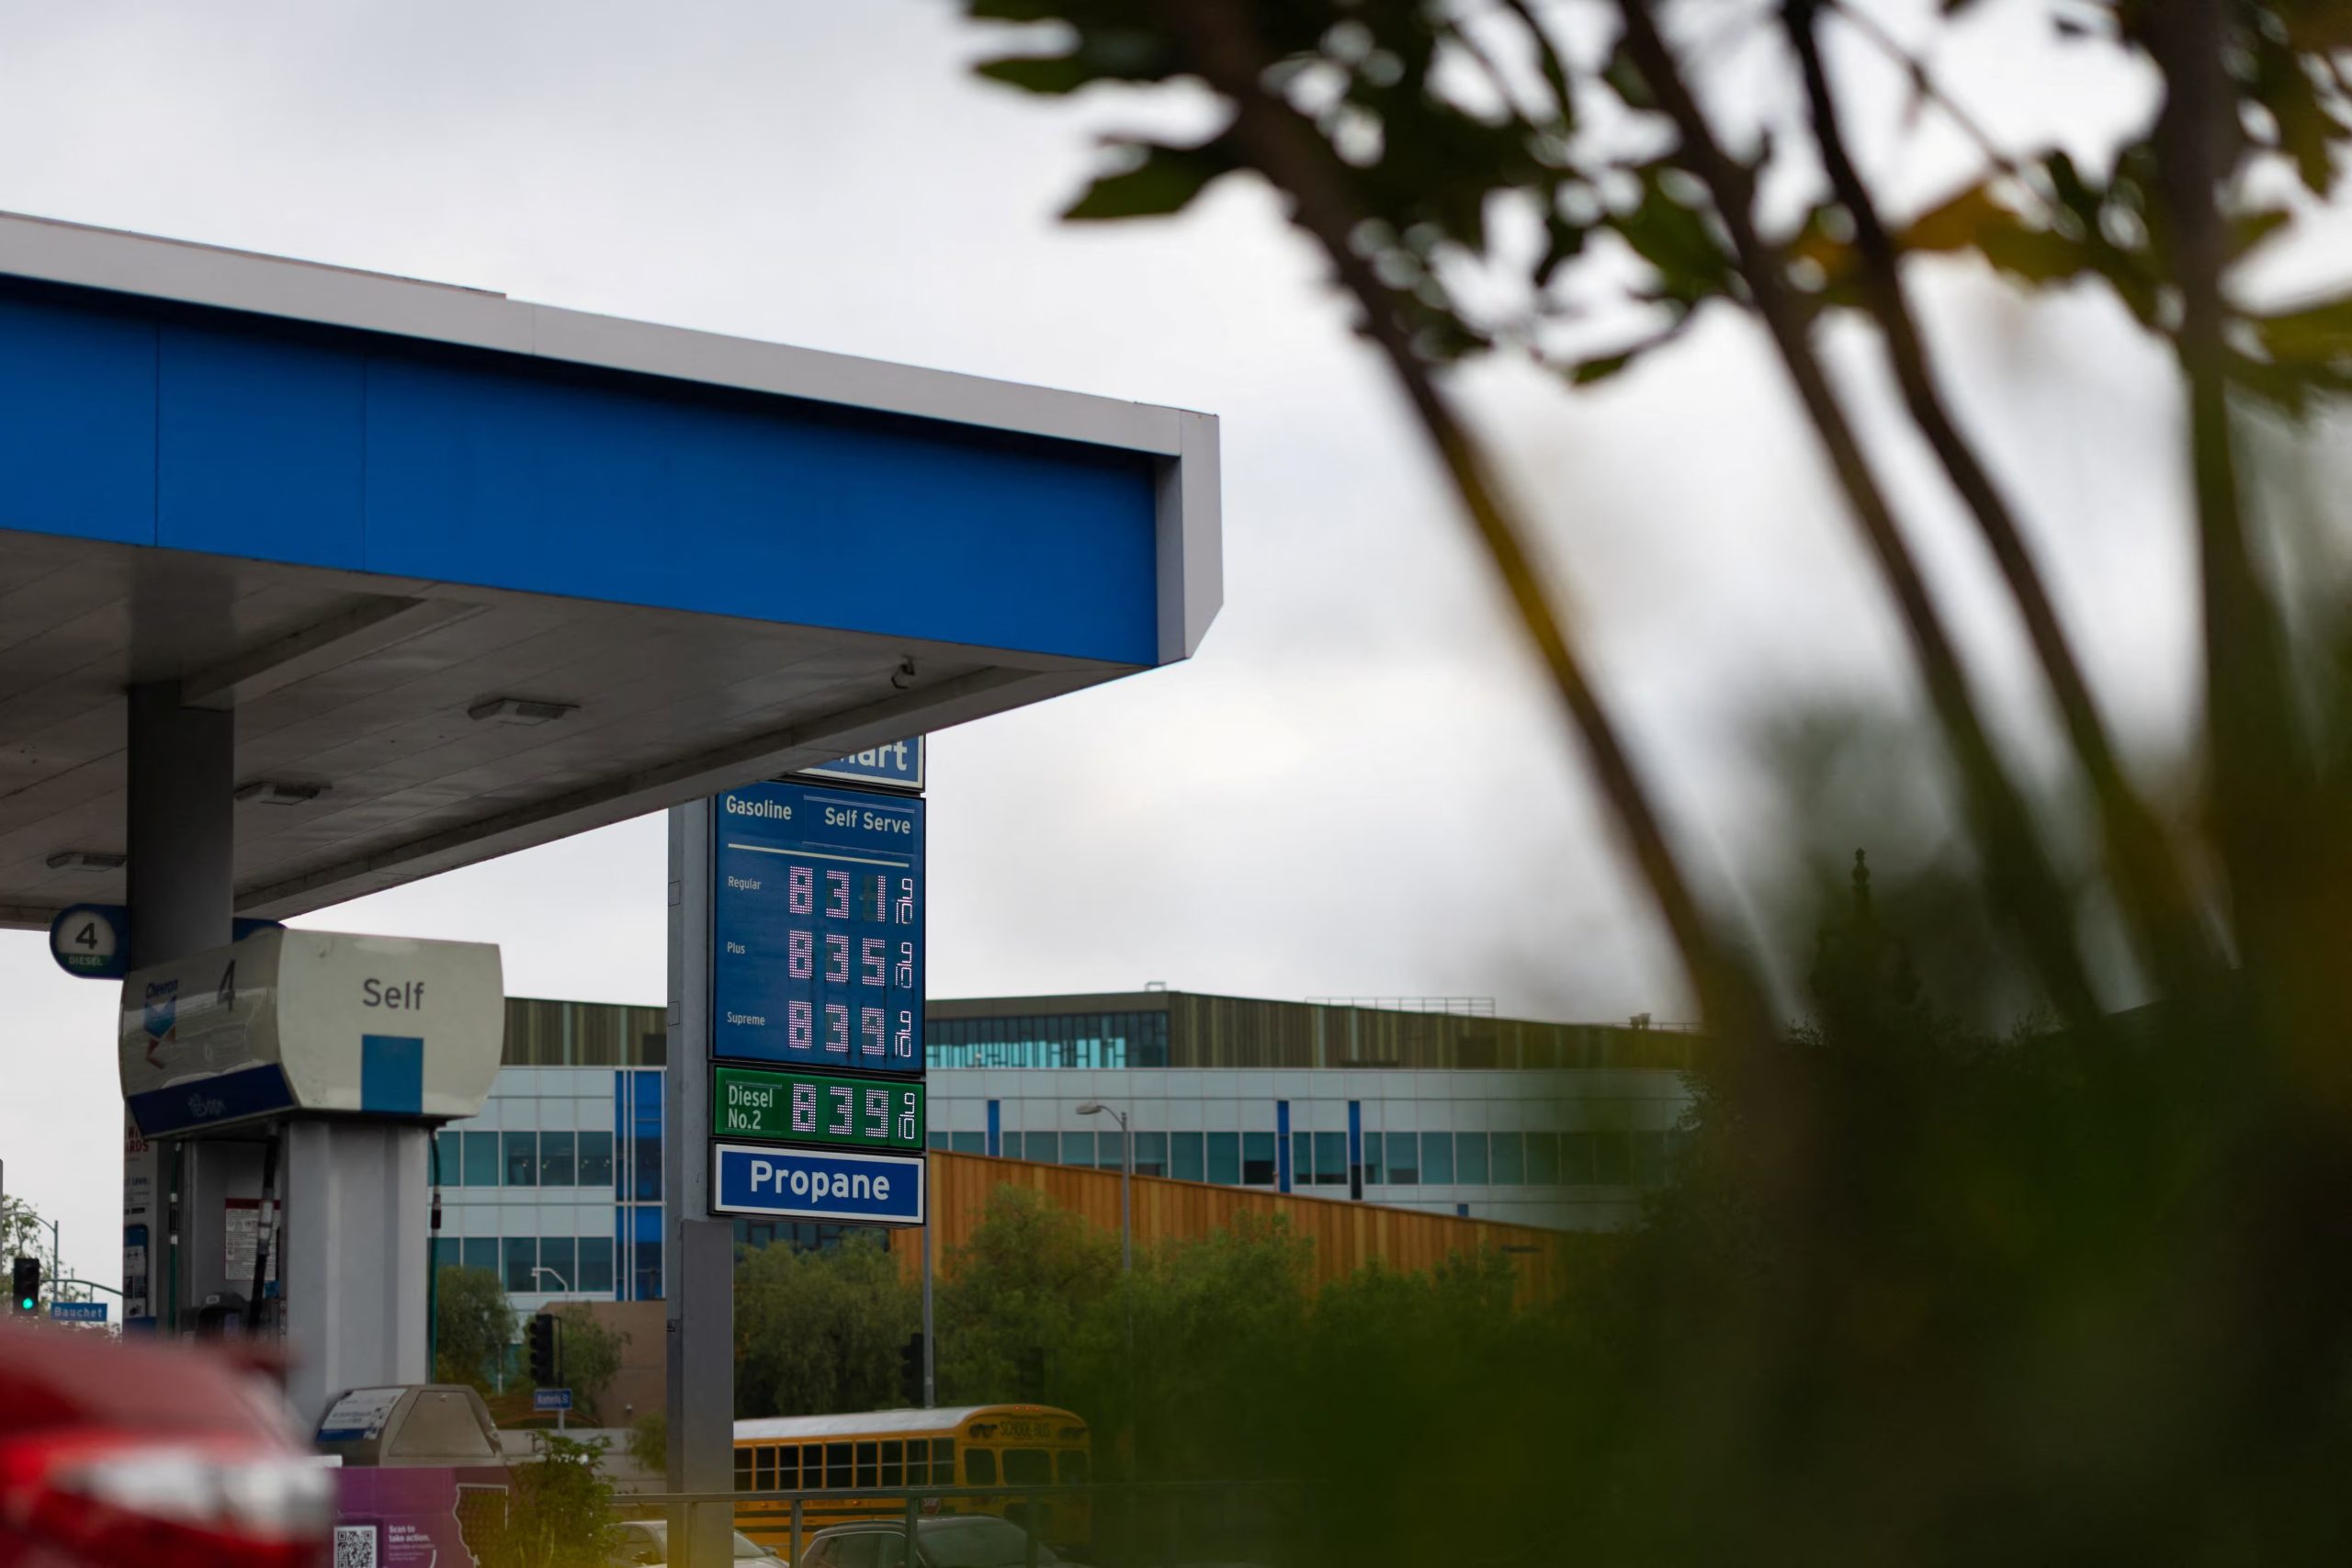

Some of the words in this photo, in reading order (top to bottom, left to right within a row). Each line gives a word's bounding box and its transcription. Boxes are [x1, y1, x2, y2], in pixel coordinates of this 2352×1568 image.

[840, 740, 908, 771] art
[726, 795, 792, 821] Gasoline
[825, 807, 857, 828] Self
[864, 812, 911, 834] Serve
[728, 875, 762, 891] Regular
[789, 866, 886, 922] 831
[75, 922, 97, 950] 4
[727, 942, 746, 954] Plus
[68, 954, 104, 966] DIESEL
[788, 930, 886, 986] 835
[217, 959, 236, 1012] 4
[362, 978, 425, 1010] Self
[727, 1012, 765, 1026] Supreme
[788, 1000, 886, 1056] 839
[728, 1085, 774, 1108] Diesel
[728, 1109, 762, 1130] No.2
[792, 1083, 889, 1138] 839
[750, 1160, 890, 1203] Propane
[53, 1305, 103, 1318] Bauchet
[389, 1525, 406, 1533] Scan
[407, 1525, 416, 1533] to
[389, 1534, 404, 1543] take
